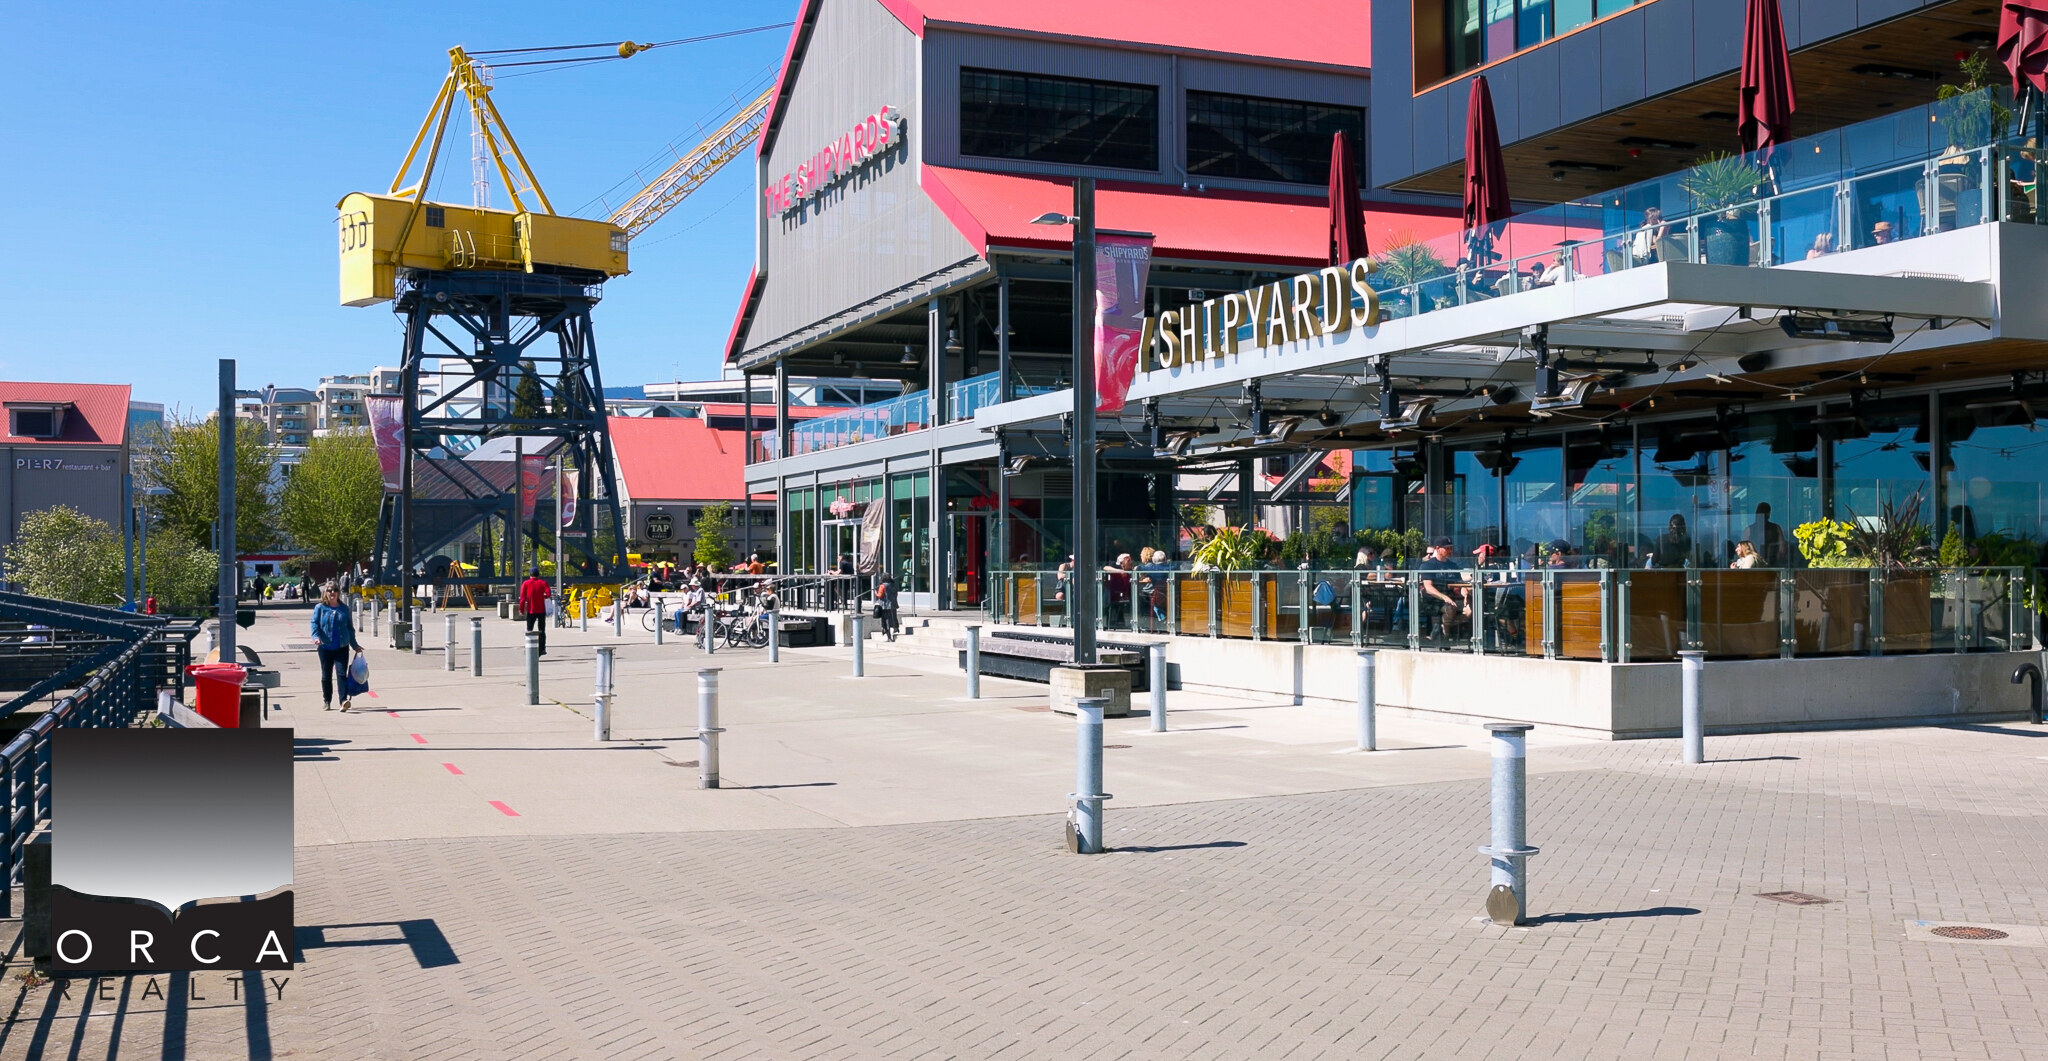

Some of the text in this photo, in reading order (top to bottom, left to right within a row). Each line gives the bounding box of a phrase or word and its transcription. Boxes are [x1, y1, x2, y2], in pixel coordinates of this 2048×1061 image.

[764, 105, 893, 218] THE SHIPYARDS
[1104, 246, 1149, 260] SHIPYARDS
[1159, 257, 1376, 369] SHIPYARDS
[16, 458, 52, 470] PIER
[54, 459, 63, 470] 7
[62, 463, 94, 471] restaurant
[101, 463, 111, 471] bar
[650, 524, 669, 532] TAP
